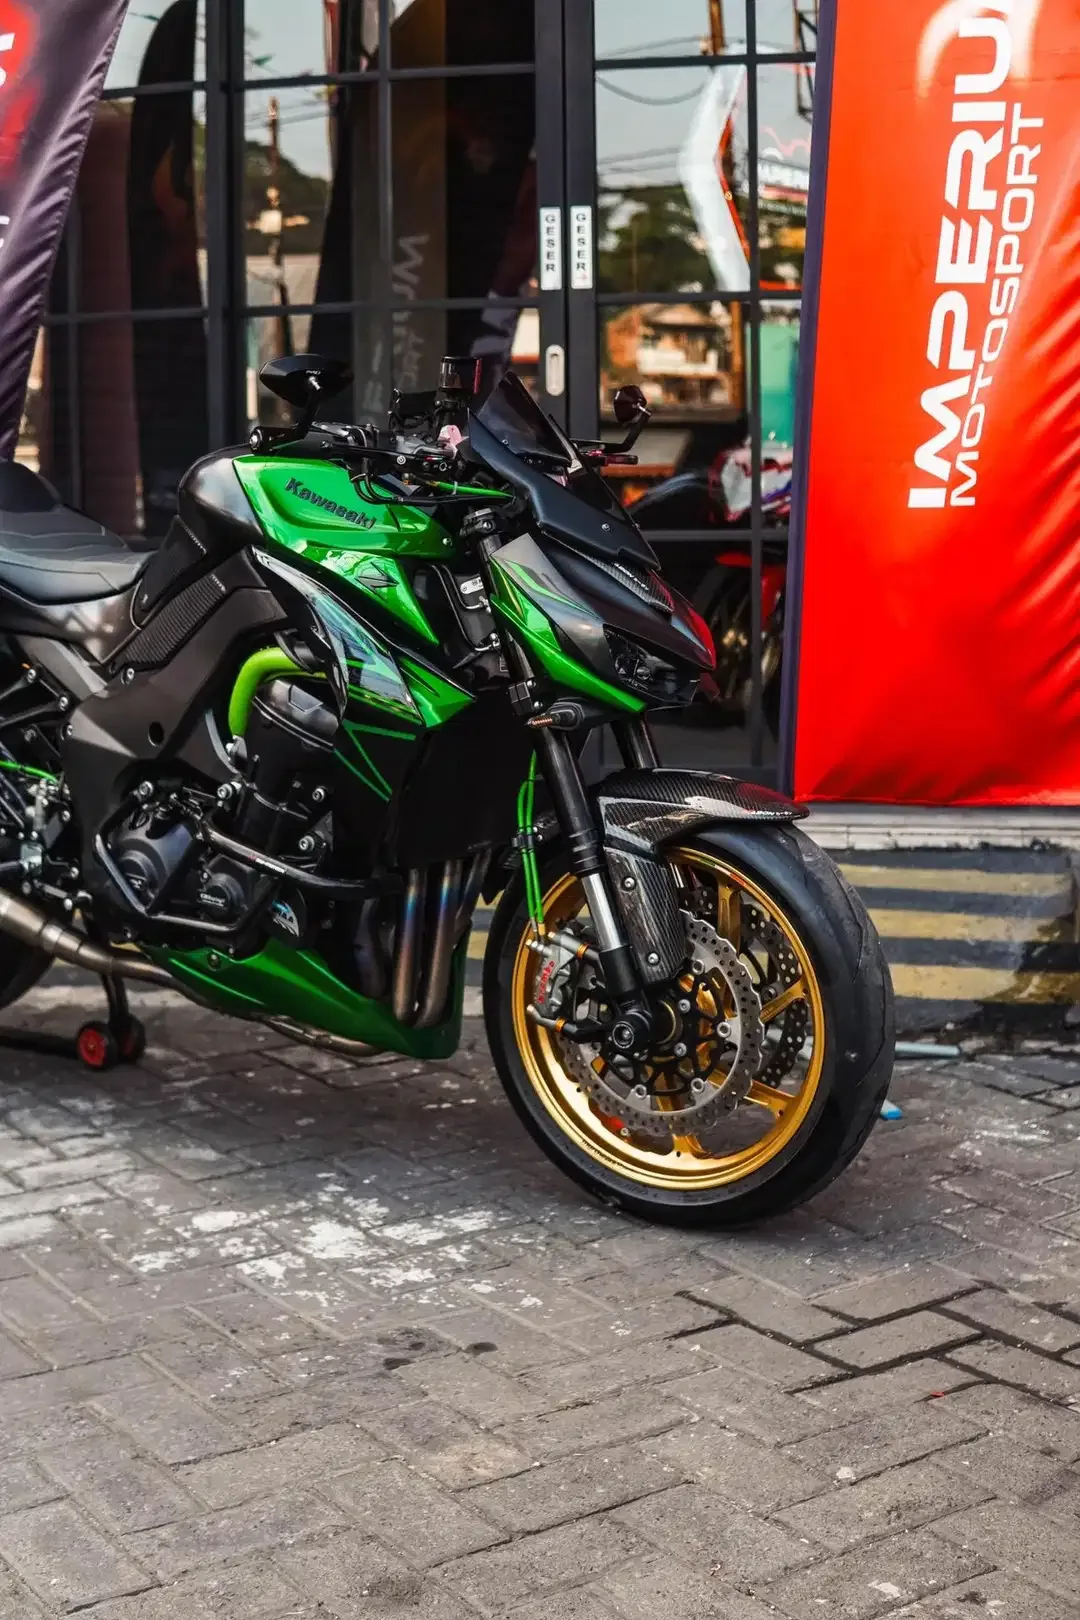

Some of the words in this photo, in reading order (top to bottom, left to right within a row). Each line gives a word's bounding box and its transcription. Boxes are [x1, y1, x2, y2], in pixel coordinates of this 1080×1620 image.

[545, 213, 556, 272] GESER
[576, 213, 586, 272] GESER
[908, 0, 1012, 508] IMPERIU
[950, 103, 1044, 507] MOTOSPORT
[285, 478, 376, 529] Kawasaki
